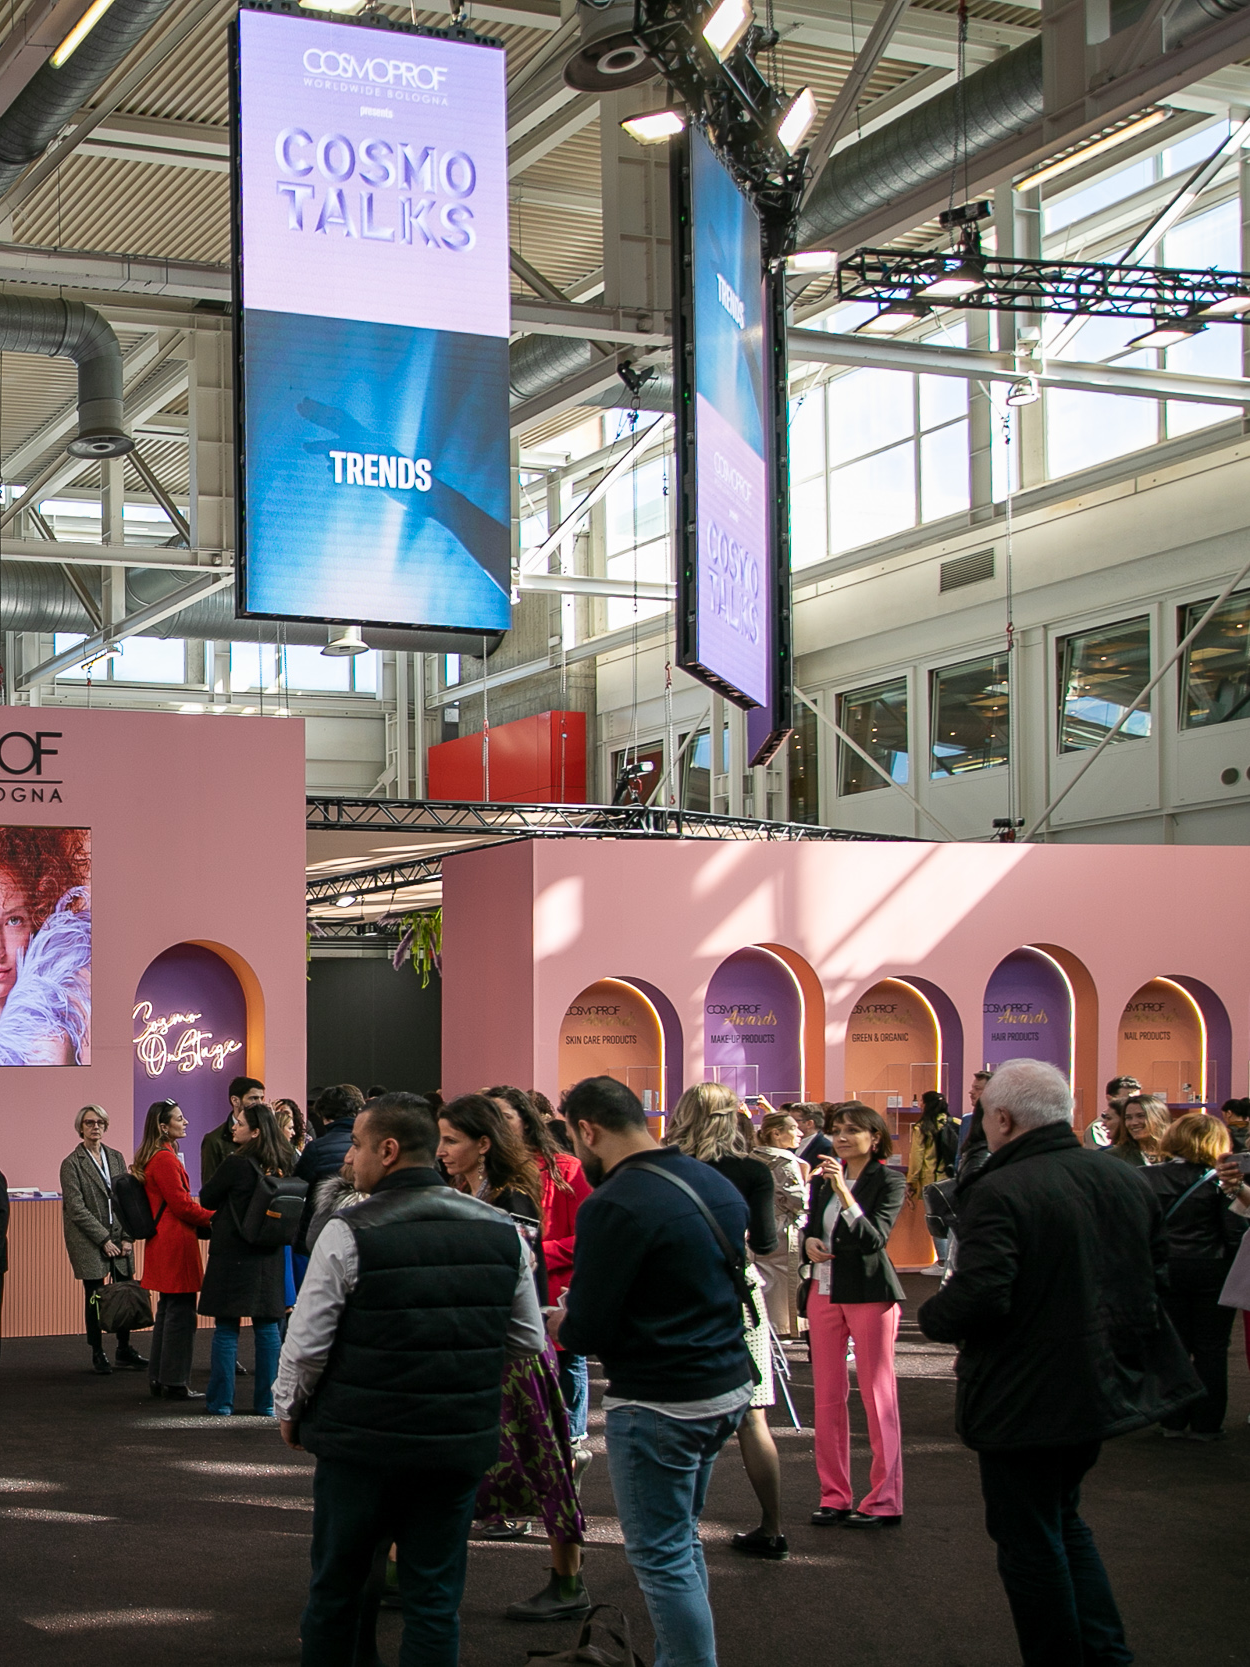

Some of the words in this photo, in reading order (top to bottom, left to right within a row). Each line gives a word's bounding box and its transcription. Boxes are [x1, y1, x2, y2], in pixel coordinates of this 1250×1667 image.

[303, 48, 448, 90] COSMOPROF
[303, 77, 381, 97] WORLDWIDE
[387, 89, 448, 106] BOLOGNA
[360, 106, 394, 119] presents
[275, 127, 477, 199] COSMO
[276, 180, 477, 252] TALKS
[716, 272, 745, 330] TRENDS
[329, 450, 432, 492] TRENDS
[707, 519, 758, 599] COSMO
[708, 566, 758, 645] TALKS
[707, 1004, 761, 1014] COSMOPROF
[851, 1004, 897, 1014] OSMOPROF
[1124, 1002, 1165, 1012] SMOPROF
[723, 1009, 778, 1026] Awards
[996, 1008, 1049, 1024] Awards
[566, 1035, 582, 1045] SKIN
[583, 1035, 601, 1045] CARE
[602, 1034, 637, 1045] PRODUCTS
[711, 1034, 740, 1044] MAKE-UP
[741, 1034, 775, 1044] PRODUCTS
[852, 1033, 873, 1042] GREEN
[874, 1033, 879, 1042] &
[880, 1032, 909, 1042] ORGANIC
[991, 1032, 1006, 1041] HAIR
[1007, 1032, 1039, 1041] PRODUCTS
[1124, 1031, 1138, 1040] NAIL
[1139, 1031, 1171, 1040] PRODUCTS
